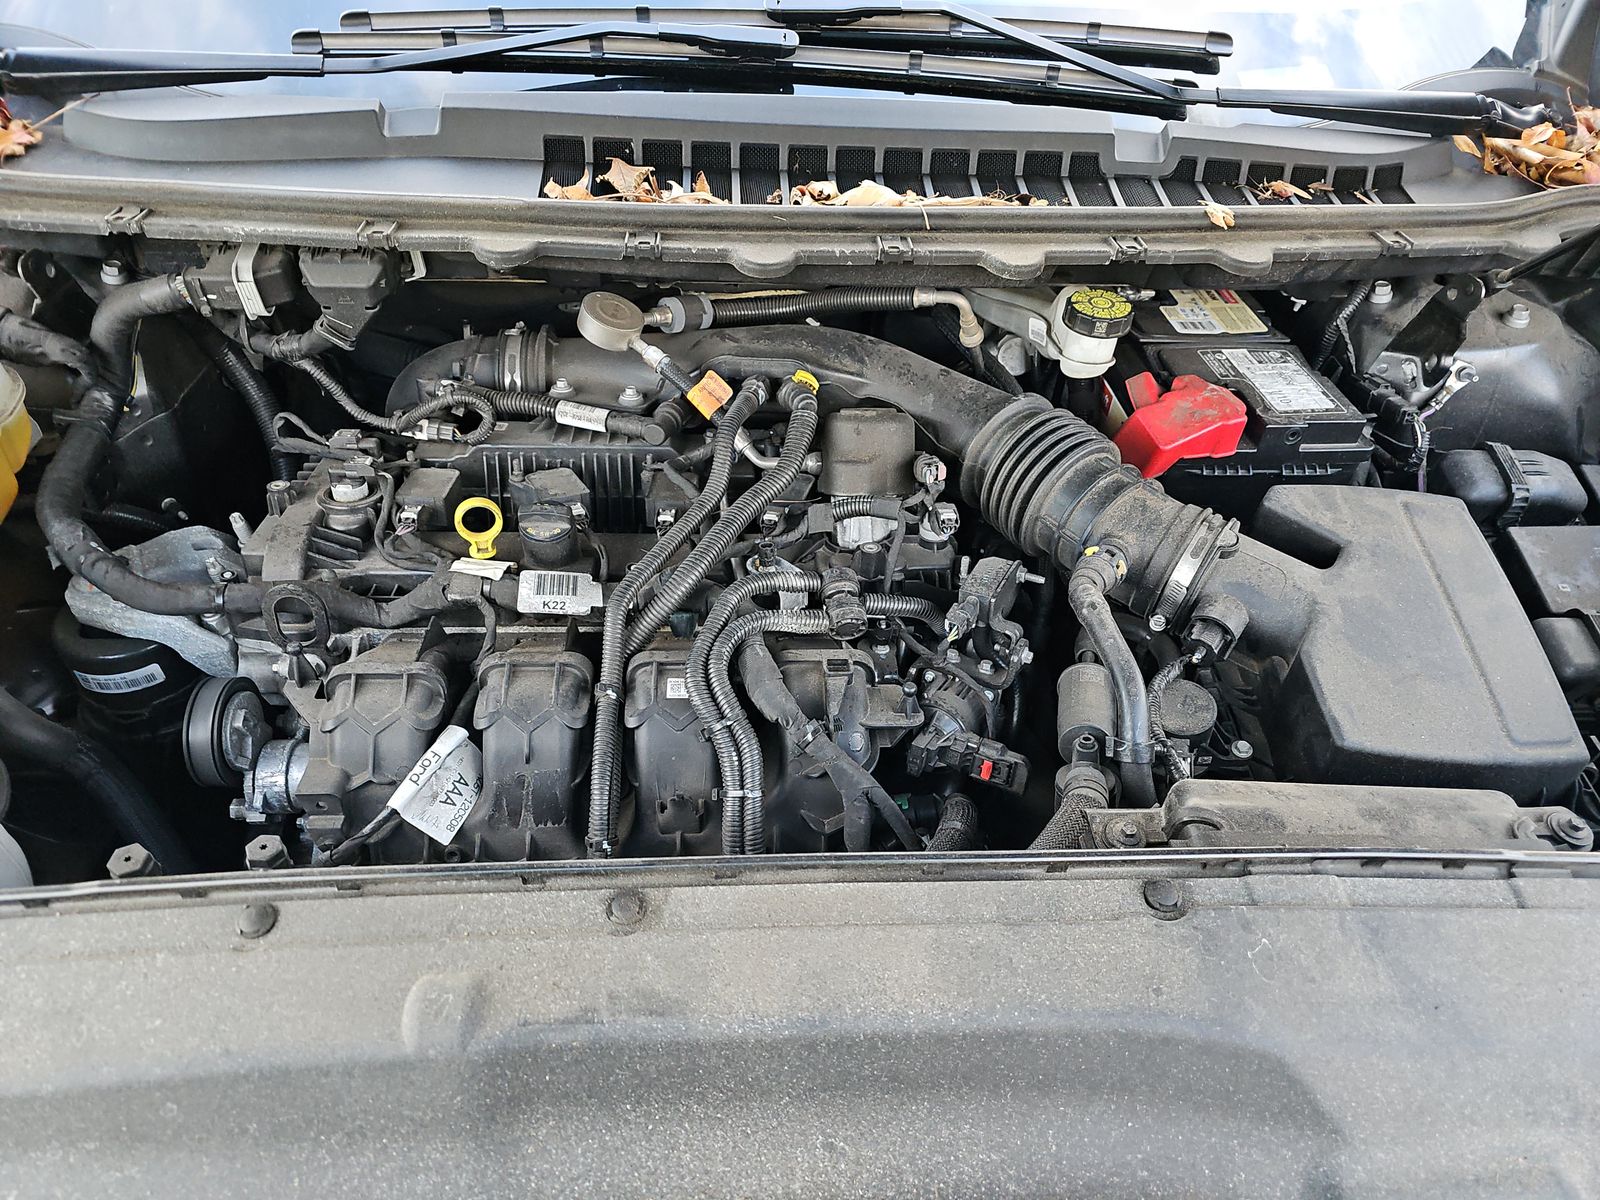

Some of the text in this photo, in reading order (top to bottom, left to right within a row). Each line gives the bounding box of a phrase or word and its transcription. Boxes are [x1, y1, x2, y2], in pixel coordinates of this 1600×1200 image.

[542, 600, 566, 610] K22
[409, 750, 441, 786] Ford
[439, 772, 470, 807] AAA
